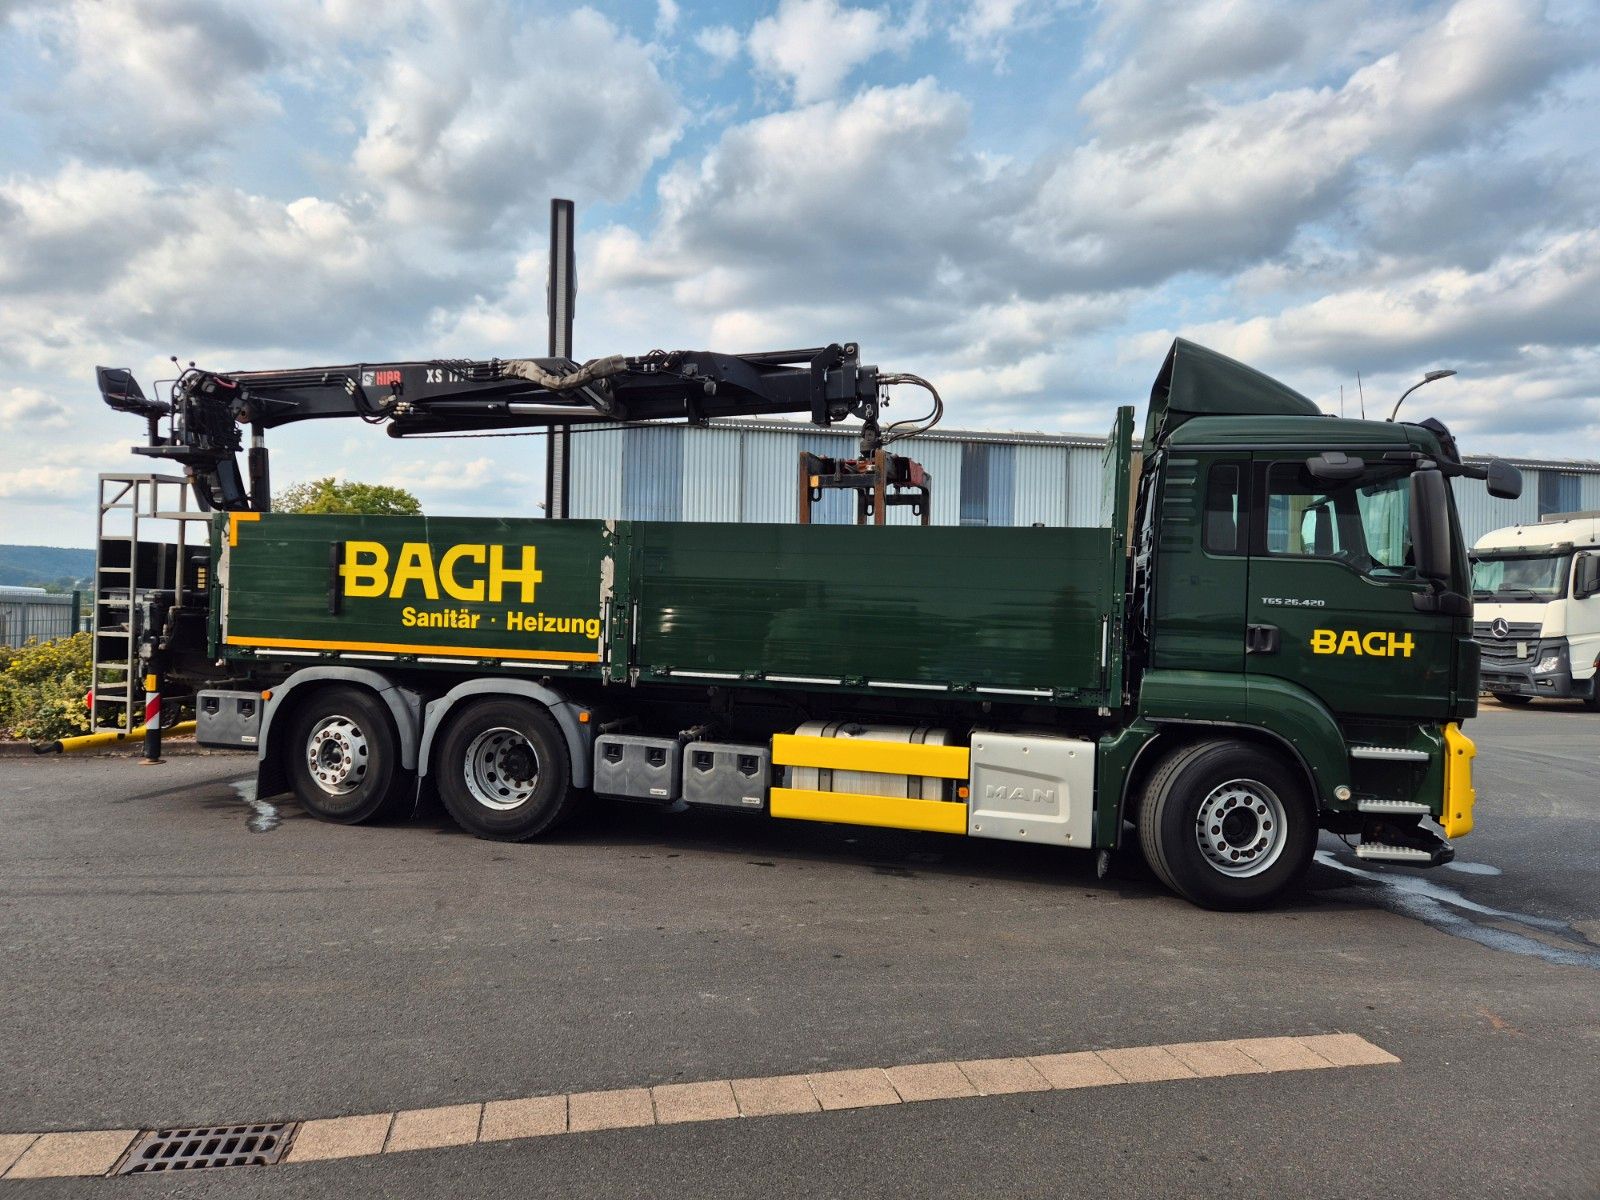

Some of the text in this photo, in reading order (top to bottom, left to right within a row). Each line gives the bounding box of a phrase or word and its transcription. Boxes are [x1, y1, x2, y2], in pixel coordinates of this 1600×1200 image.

[426, 368, 443, 383] XS
[339, 541, 543, 603] BACH
[1261, 597, 1325, 607] TGS 26.420
[402, 607, 600, 639] Sanitär Heizung
[1310, 629, 1415, 658] BACH
[986, 785, 1055, 804] MAN
